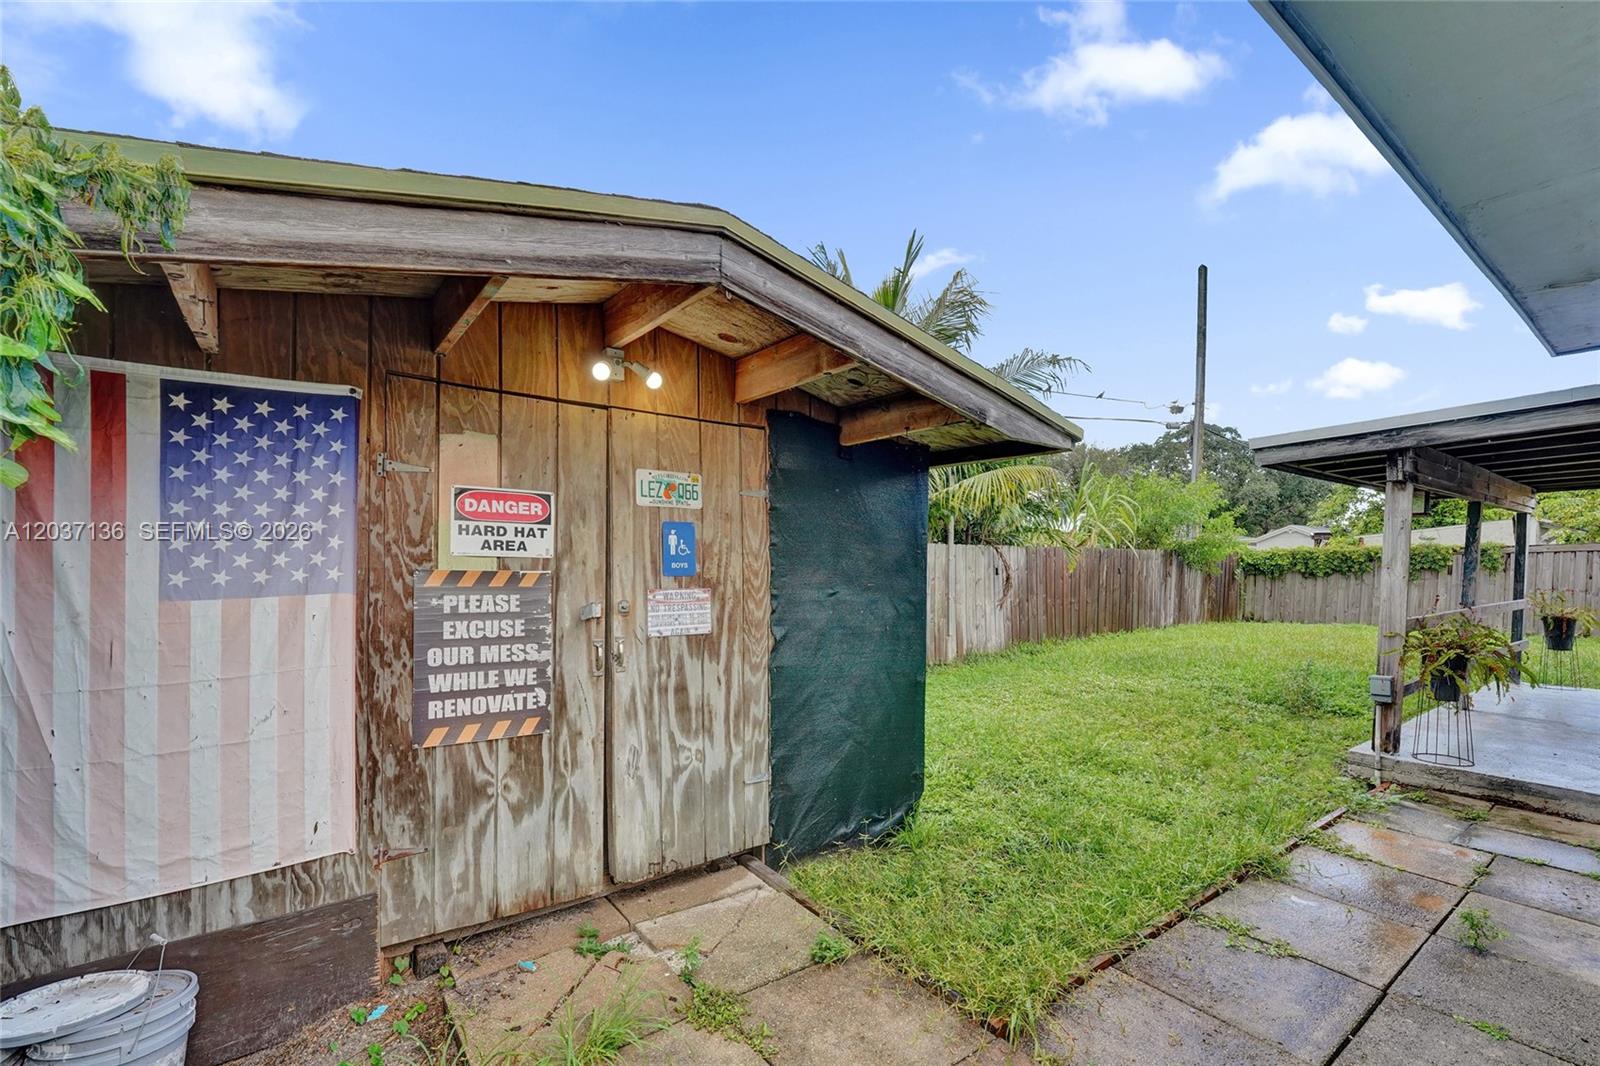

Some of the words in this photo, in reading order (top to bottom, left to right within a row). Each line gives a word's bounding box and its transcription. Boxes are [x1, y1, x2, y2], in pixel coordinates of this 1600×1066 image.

[464, 498, 543, 516] DANGER
[457, 523, 508, 537] HARD
[514, 526, 548, 539] HAT
[480, 539, 528, 552] AREA
[442, 594, 521, 614] PLEASE
[662, 591, 697, 600] WARNING
[442, 619, 526, 640] EXCUSE
[426, 646, 474, 668] OUR
[480, 643, 539, 664] MESS
[427, 669, 500, 694] WHILE
[503, 667, 538, 688] WE
[427, 691, 538, 720] RENOVATE
